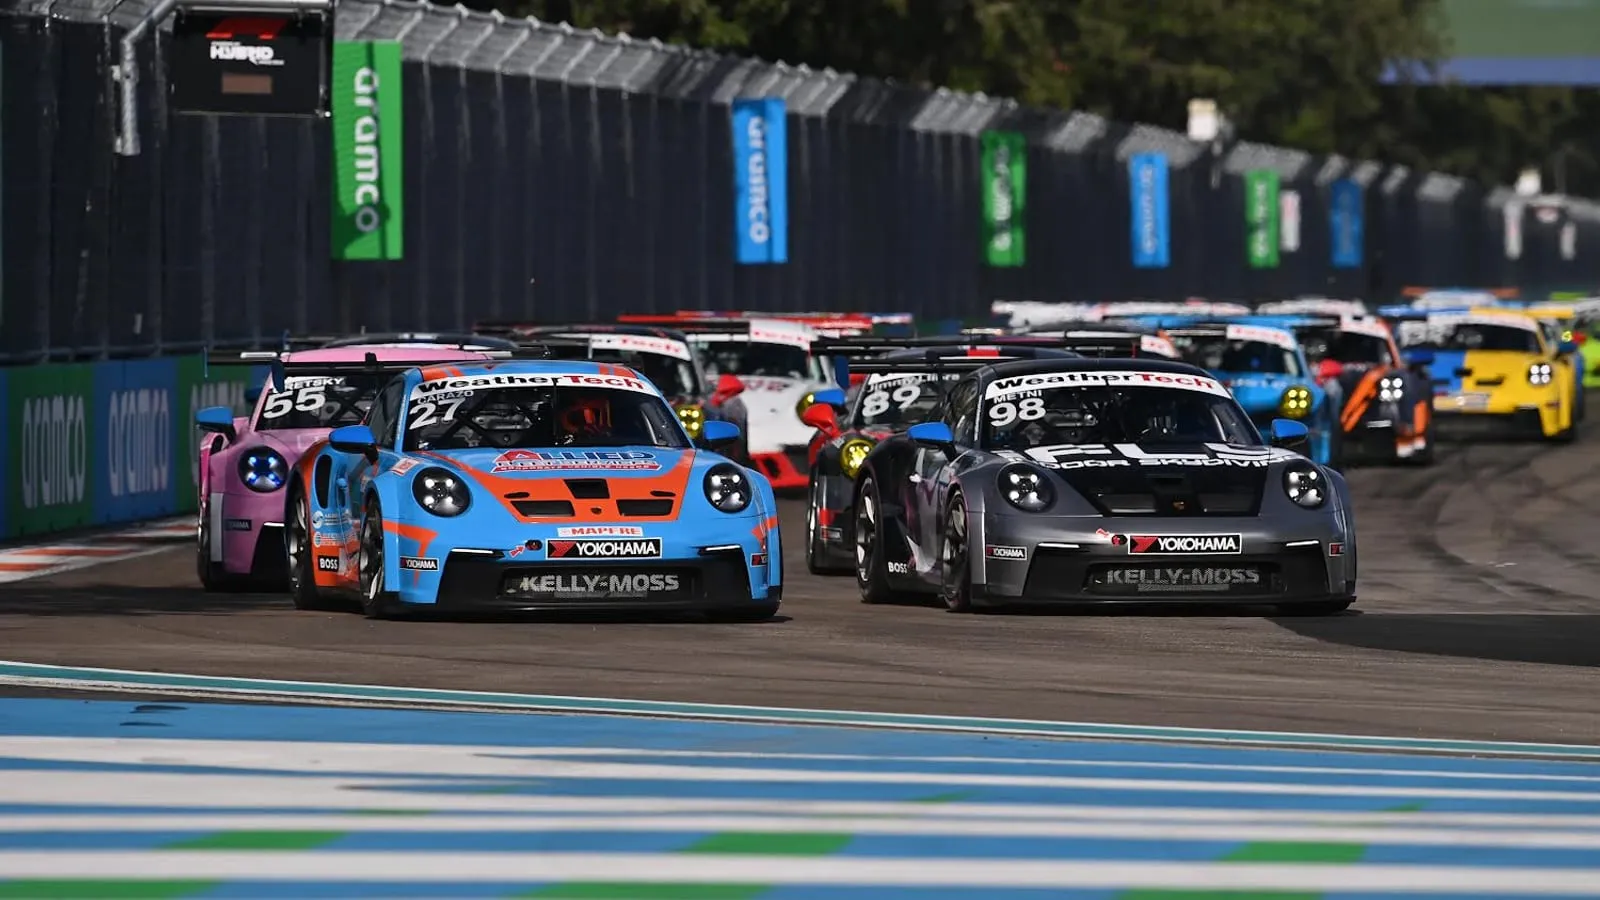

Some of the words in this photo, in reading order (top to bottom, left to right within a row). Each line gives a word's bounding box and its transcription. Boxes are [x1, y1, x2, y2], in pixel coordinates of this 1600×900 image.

[355, 67, 379, 232] aramco
[418, 375, 643, 393] WeatherTech
[995, 372, 1214, 390] WeatherTech
[263, 386, 326, 419] 55
[417, 390, 474, 404] CARAZO
[862, 385, 921, 417] 89
[993, 389, 1042, 404] METNI
[409, 398, 466, 430] 27
[989, 398, 1046, 427] 98
[108, 388, 169, 496] aramco
[22, 394, 85, 509] aramco
[494, 449, 656, 463] ALLIED
[571, 527, 641, 535] MAPFRE
[576, 542, 658, 556] YOKOHAMA
[1158, 537, 1237, 552] YOKOHAMA
[319, 558, 338, 570] BOSS
[888, 561, 908, 574] BOSS
[520, 574, 680, 593] KELLY-MOSS
[1106, 567, 1261, 585] KELLY-MOSS
